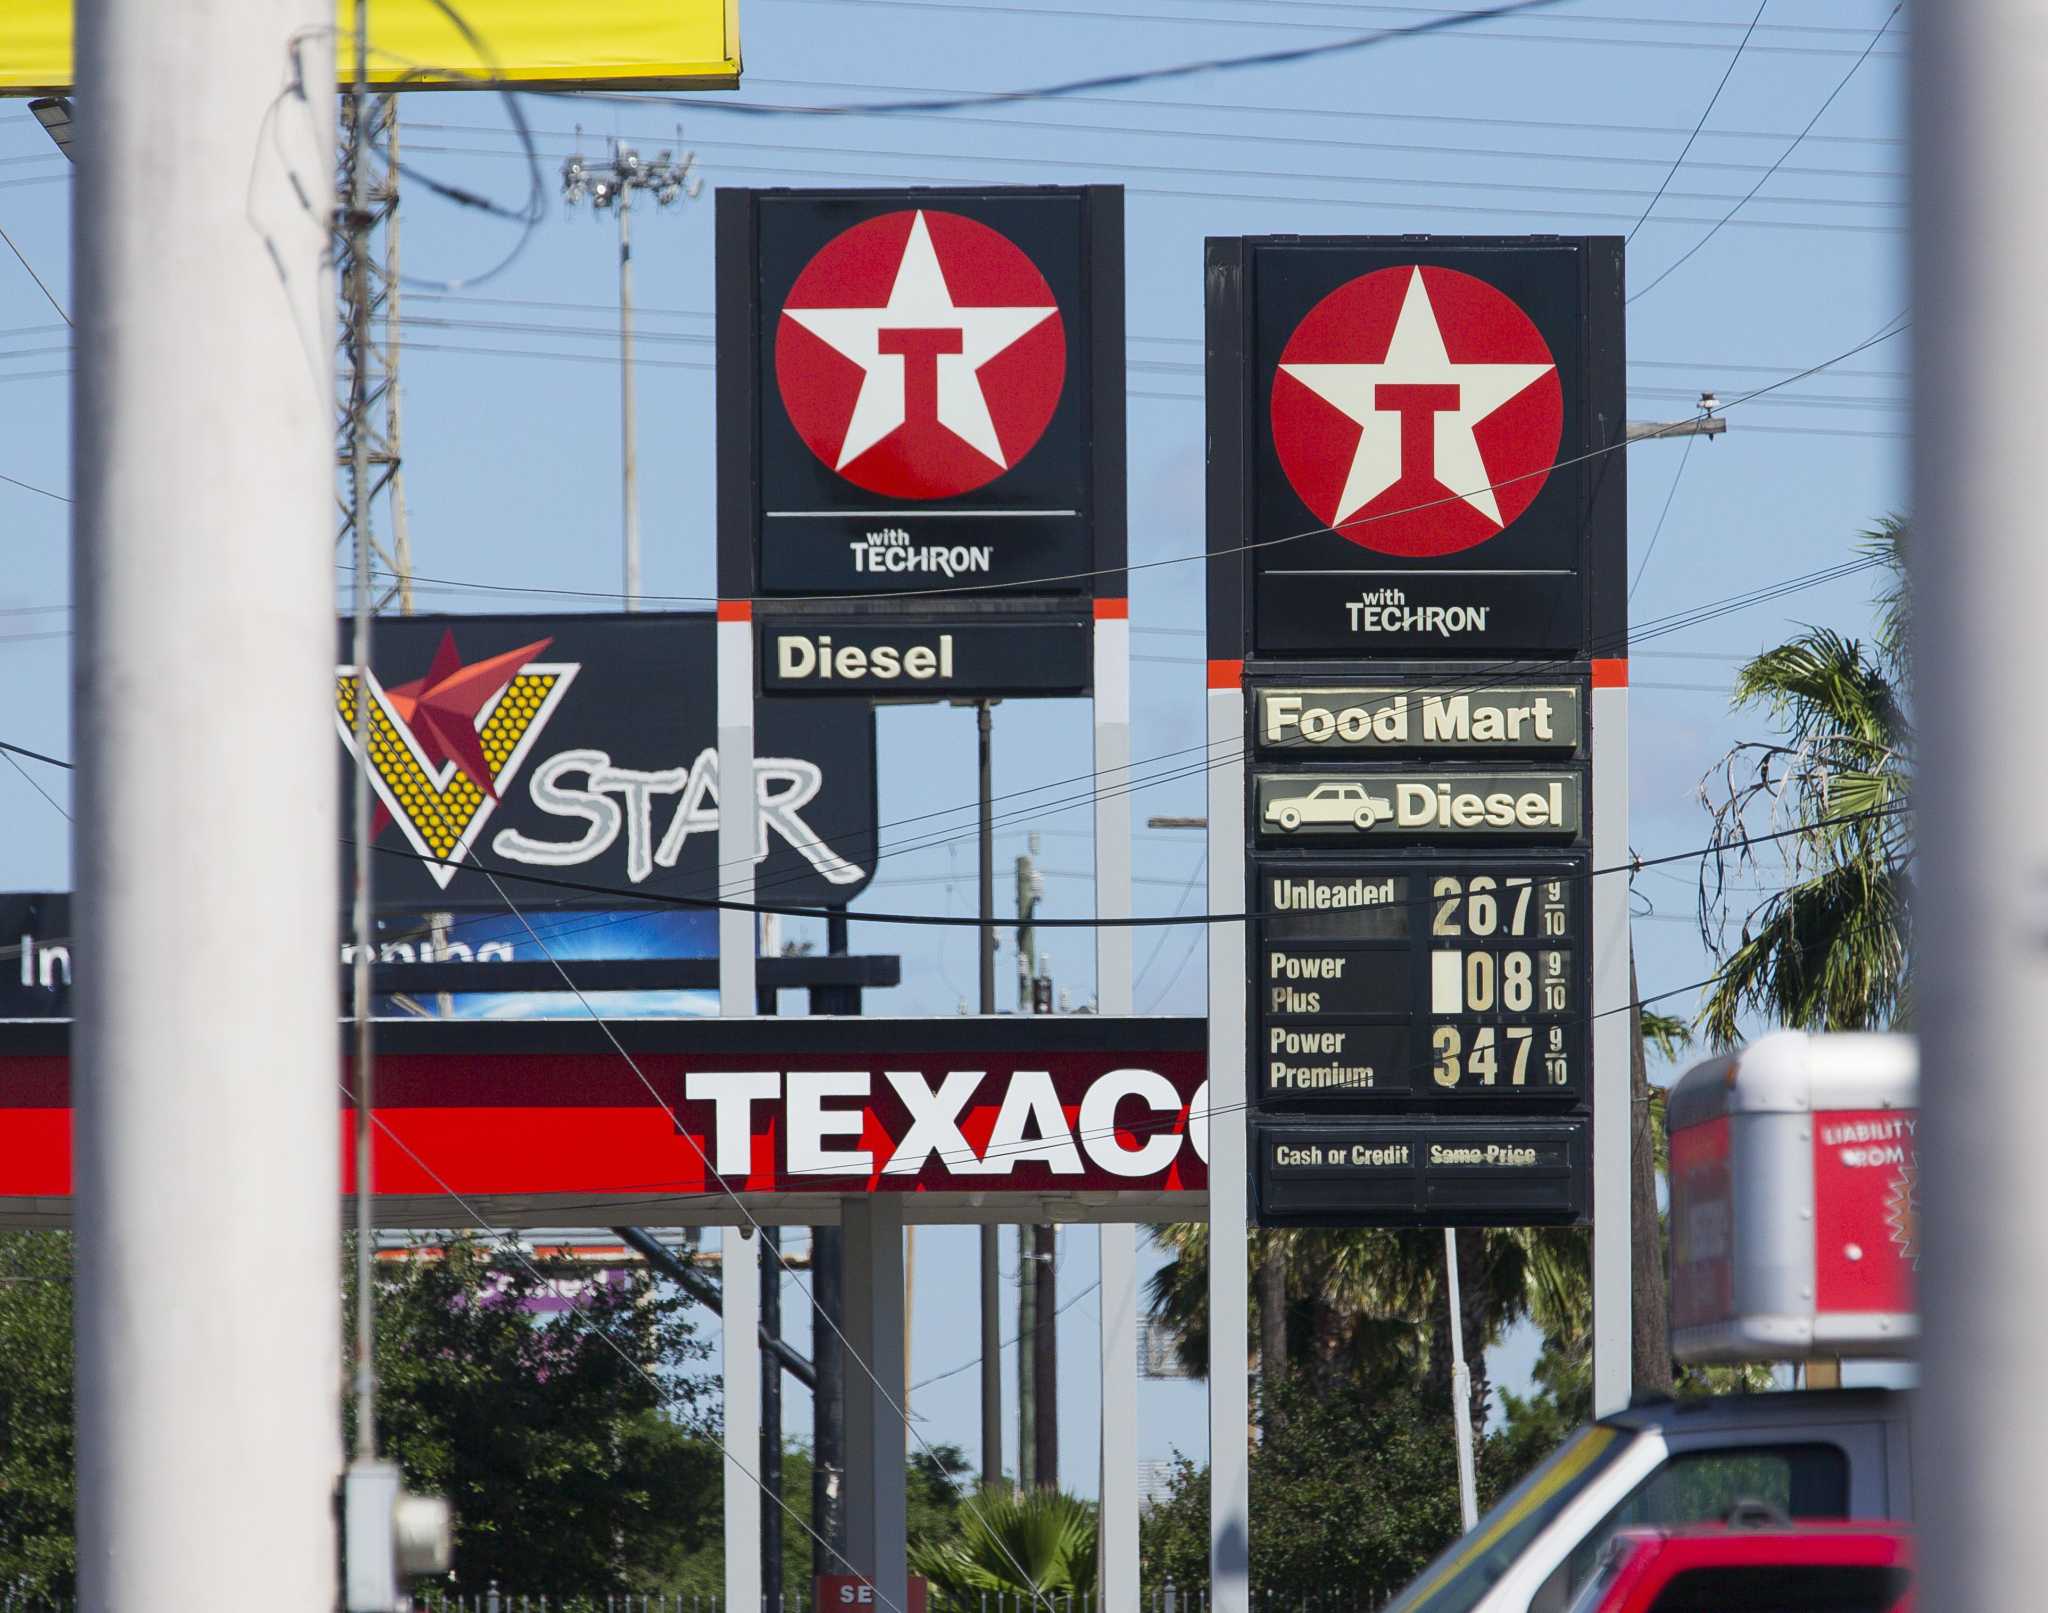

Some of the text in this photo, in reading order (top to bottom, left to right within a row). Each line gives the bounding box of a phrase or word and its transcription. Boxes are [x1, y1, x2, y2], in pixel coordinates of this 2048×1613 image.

[867, 529, 910, 546] with
[1363, 588, 1405, 605] with
[777, 634, 953, 680] Diesel
[1266, 696, 1554, 742] Food Mart
[1396, 782, 1563, 828] Diesel
[1273, 878, 1395, 910] Unleaded
[1432, 876, 1533, 936] 267
[1270, 952, 1346, 979] Power
[1271, 986, 1321, 1013] Plus
[1270, 1027, 1346, 1054] Power
[1432, 1026, 1533, 1087] 347
[1270, 1061, 1375, 1088] Premium
[685, 1068, 1209, 1178] TEXAC
[1276, 1145, 1409, 1166] Cash or Credit
[1842, 1145, 1905, 1168] ROM
